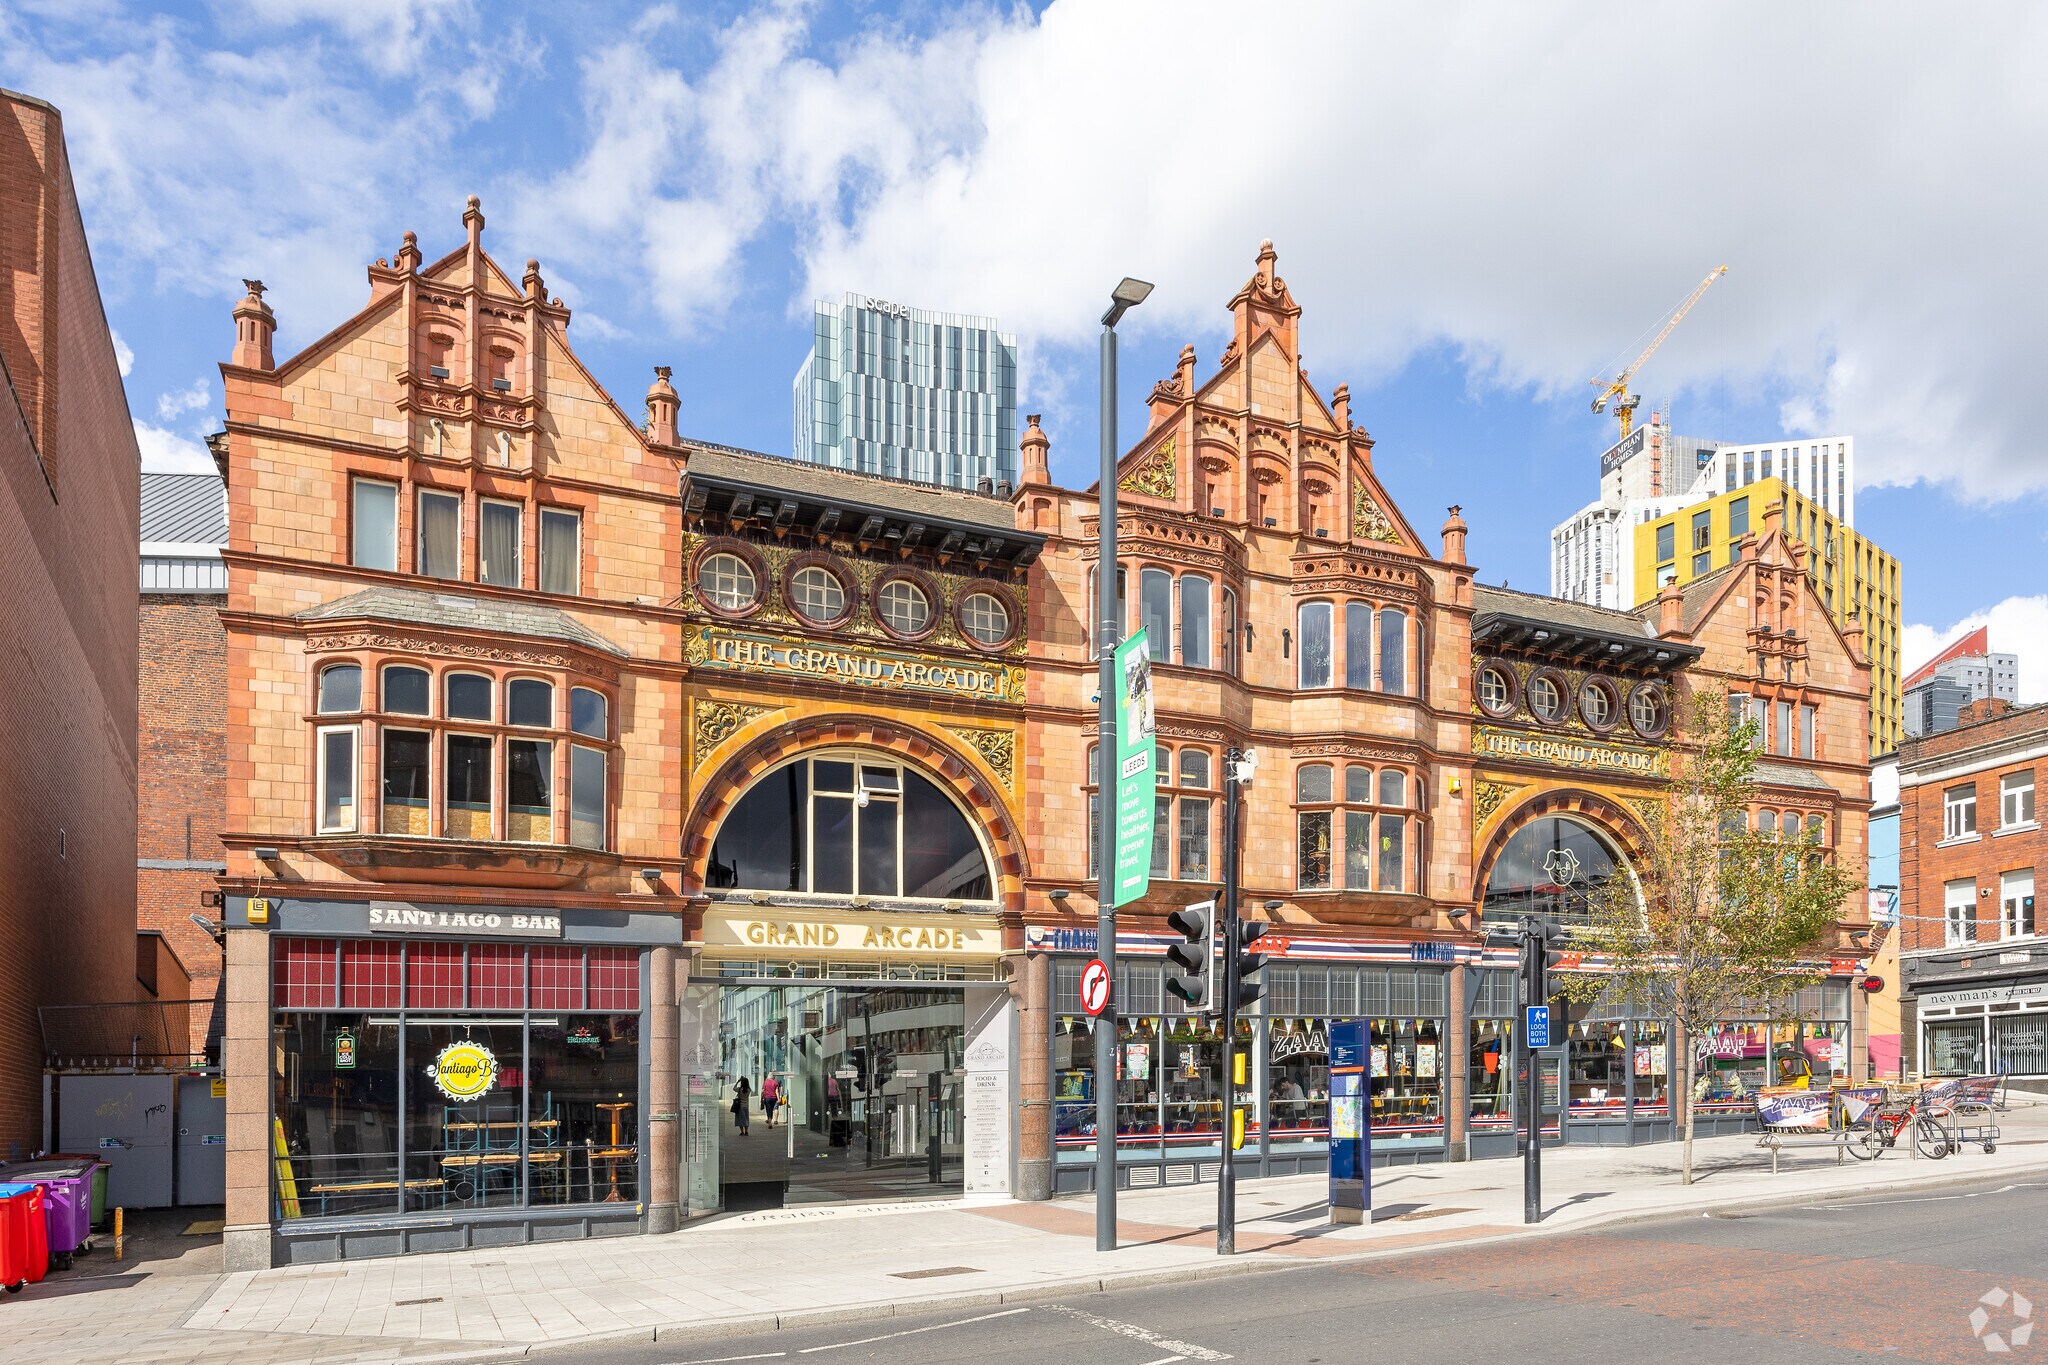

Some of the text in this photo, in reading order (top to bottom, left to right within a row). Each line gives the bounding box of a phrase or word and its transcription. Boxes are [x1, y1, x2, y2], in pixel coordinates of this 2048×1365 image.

[866, 296, 908, 320] scape
[1603, 432, 1641, 465] OLYMPIAN
[1611, 447, 1634, 469] HOMES
[712, 638, 996, 693] THE GRAND ARCADE
[1486, 734, 1652, 771] THE GRAND ARCADE
[1125, 756, 1146, 774] LEEDS
[1121, 781, 1139, 798] Let's
[1121, 798, 1140, 811] move
[1121, 807, 1148, 825] towards
[1120, 820, 1150, 841] healthier,
[1120, 839, 1146, 857] greener
[1119, 853, 1139, 870] travel.
[370, 909, 561, 930] SANTIAGO BAR
[747, 922, 963, 949] GRAND ARCADE
[1053, 927, 1087, 950] THAI
[1248, 937, 1291, 956] ZAAP
[1411, 942, 1437, 960] THAI
[1437, 942, 1456, 950] STREET
[1437, 950, 1455, 961] FOOD
[1830, 959, 1857, 975] ZAAP
[1930, 989, 1998, 1004] newman's
[1271, 1027, 1329, 1064] ZAA
[1696, 1034, 1747, 1062] ZAAP
[424, 1059, 478, 1078] Santiago
[1771, 1096, 1818, 1114] ZAAP
